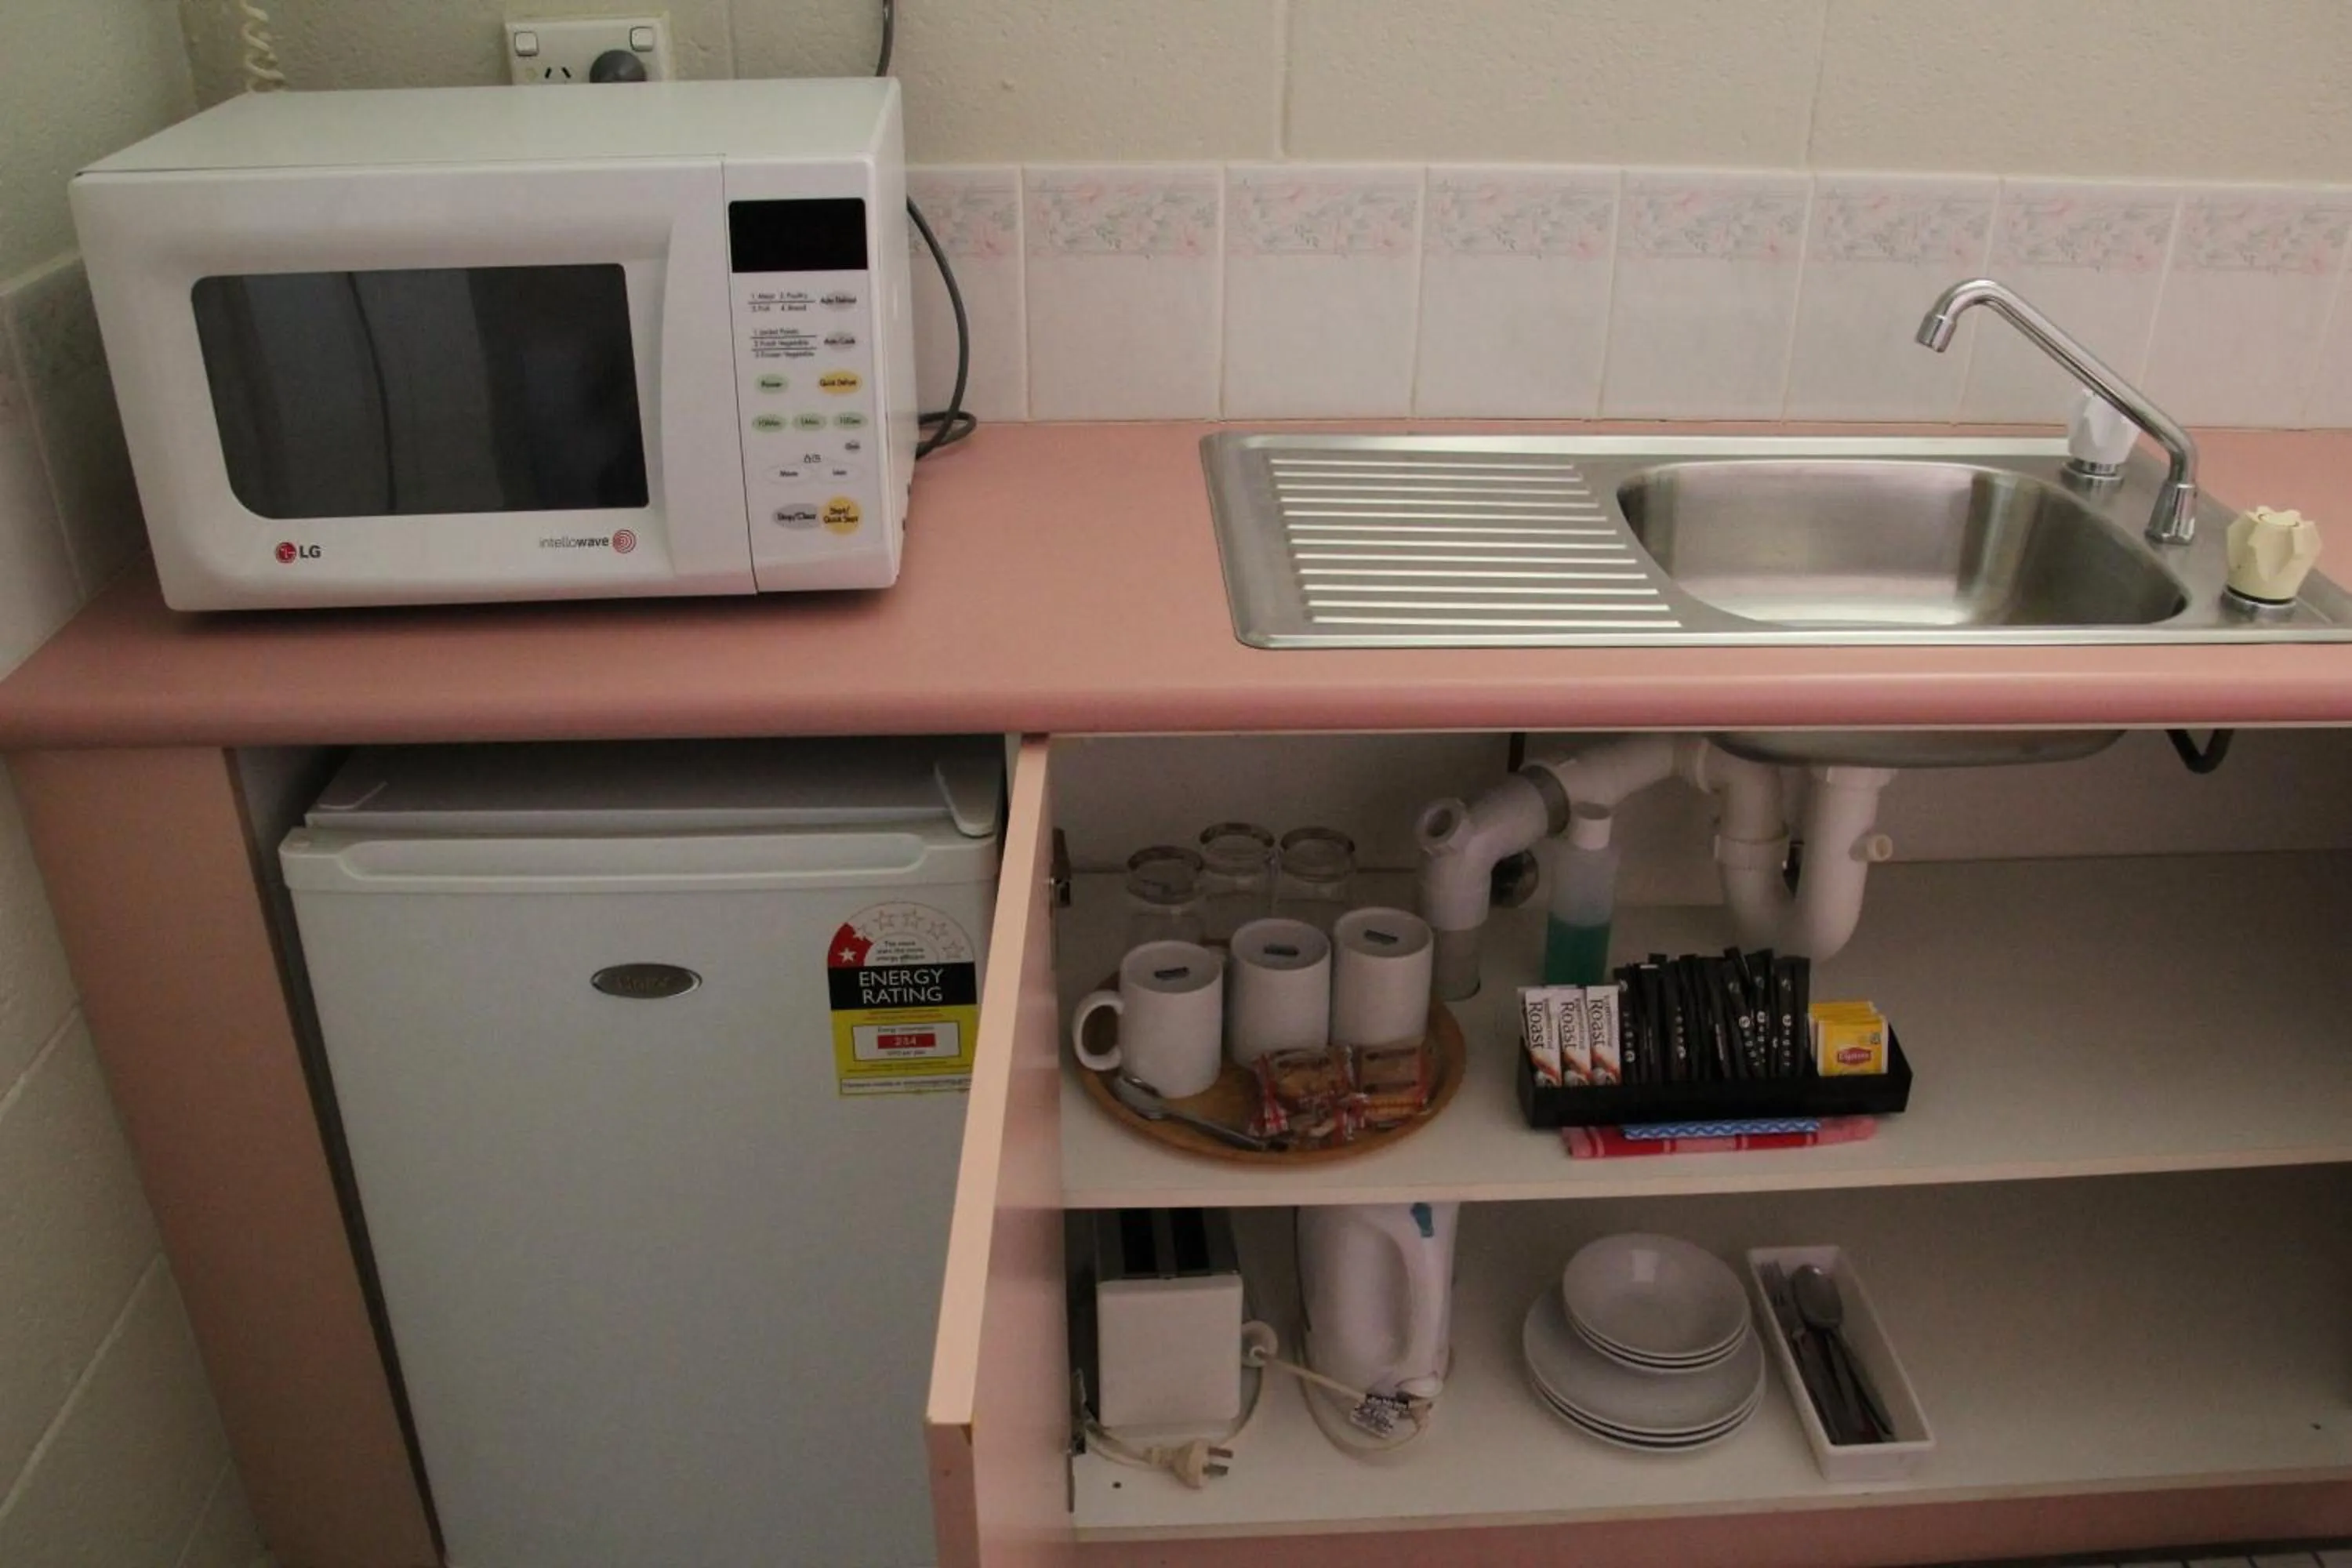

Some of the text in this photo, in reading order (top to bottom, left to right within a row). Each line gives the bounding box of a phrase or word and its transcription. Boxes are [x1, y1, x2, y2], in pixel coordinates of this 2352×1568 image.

[299, 545, 321, 558] LG
[539, 536, 609, 548] intellowave
[858, 968, 944, 988] ENERGY
[863, 986, 943, 1005] RATING
[1528, 1000, 1545, 1049] Roast
[1561, 1000, 1577, 1049] Roast
[1589, 999, 1606, 1047] Roast
